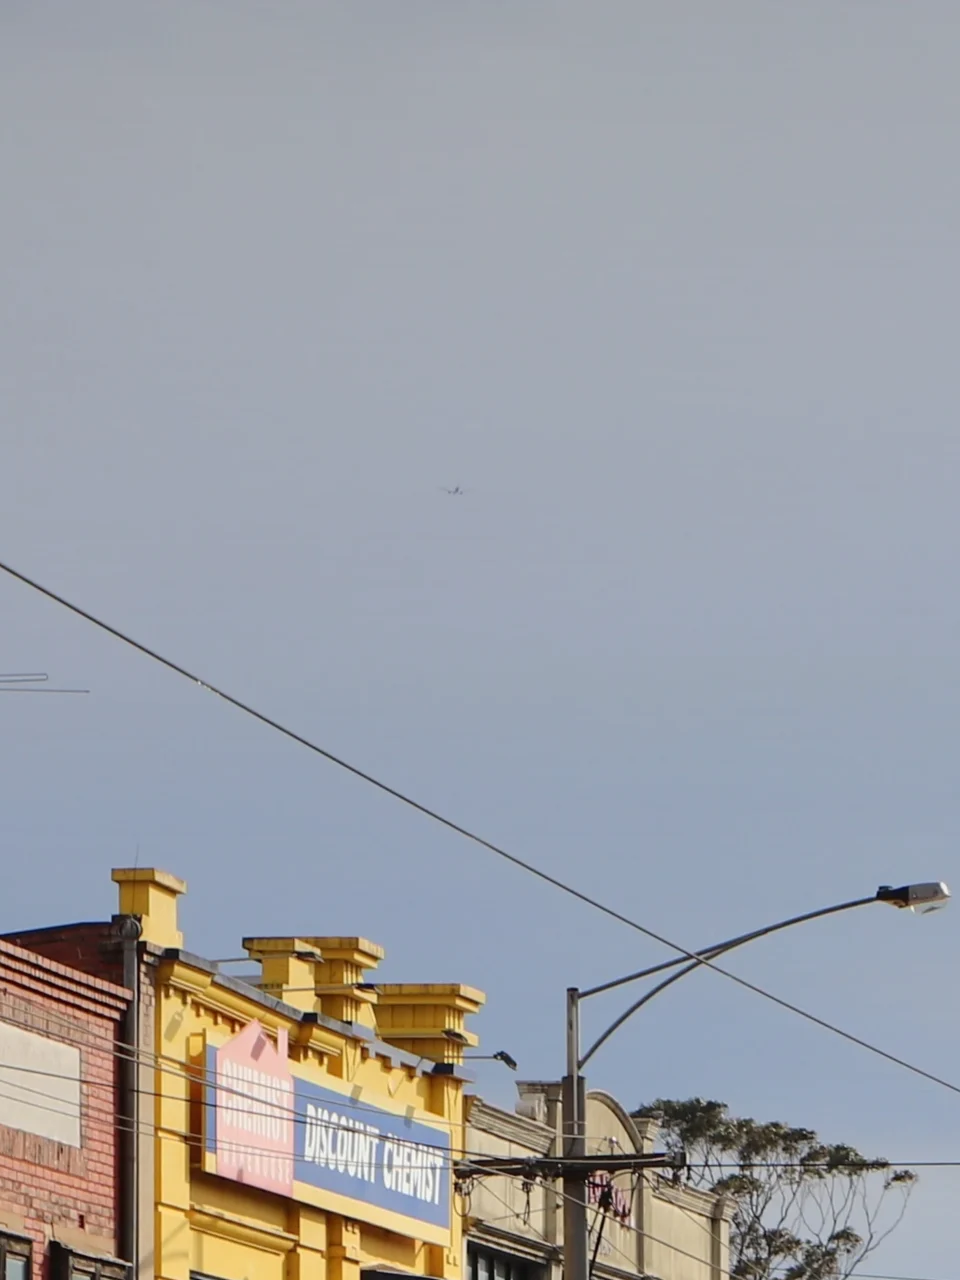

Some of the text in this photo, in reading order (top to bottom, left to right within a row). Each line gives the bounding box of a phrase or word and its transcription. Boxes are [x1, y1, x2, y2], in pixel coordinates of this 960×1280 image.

[222, 1058, 290, 1145] CHEMIST
[304, 1103, 444, 1206] DISCOUNT CHEMIST
